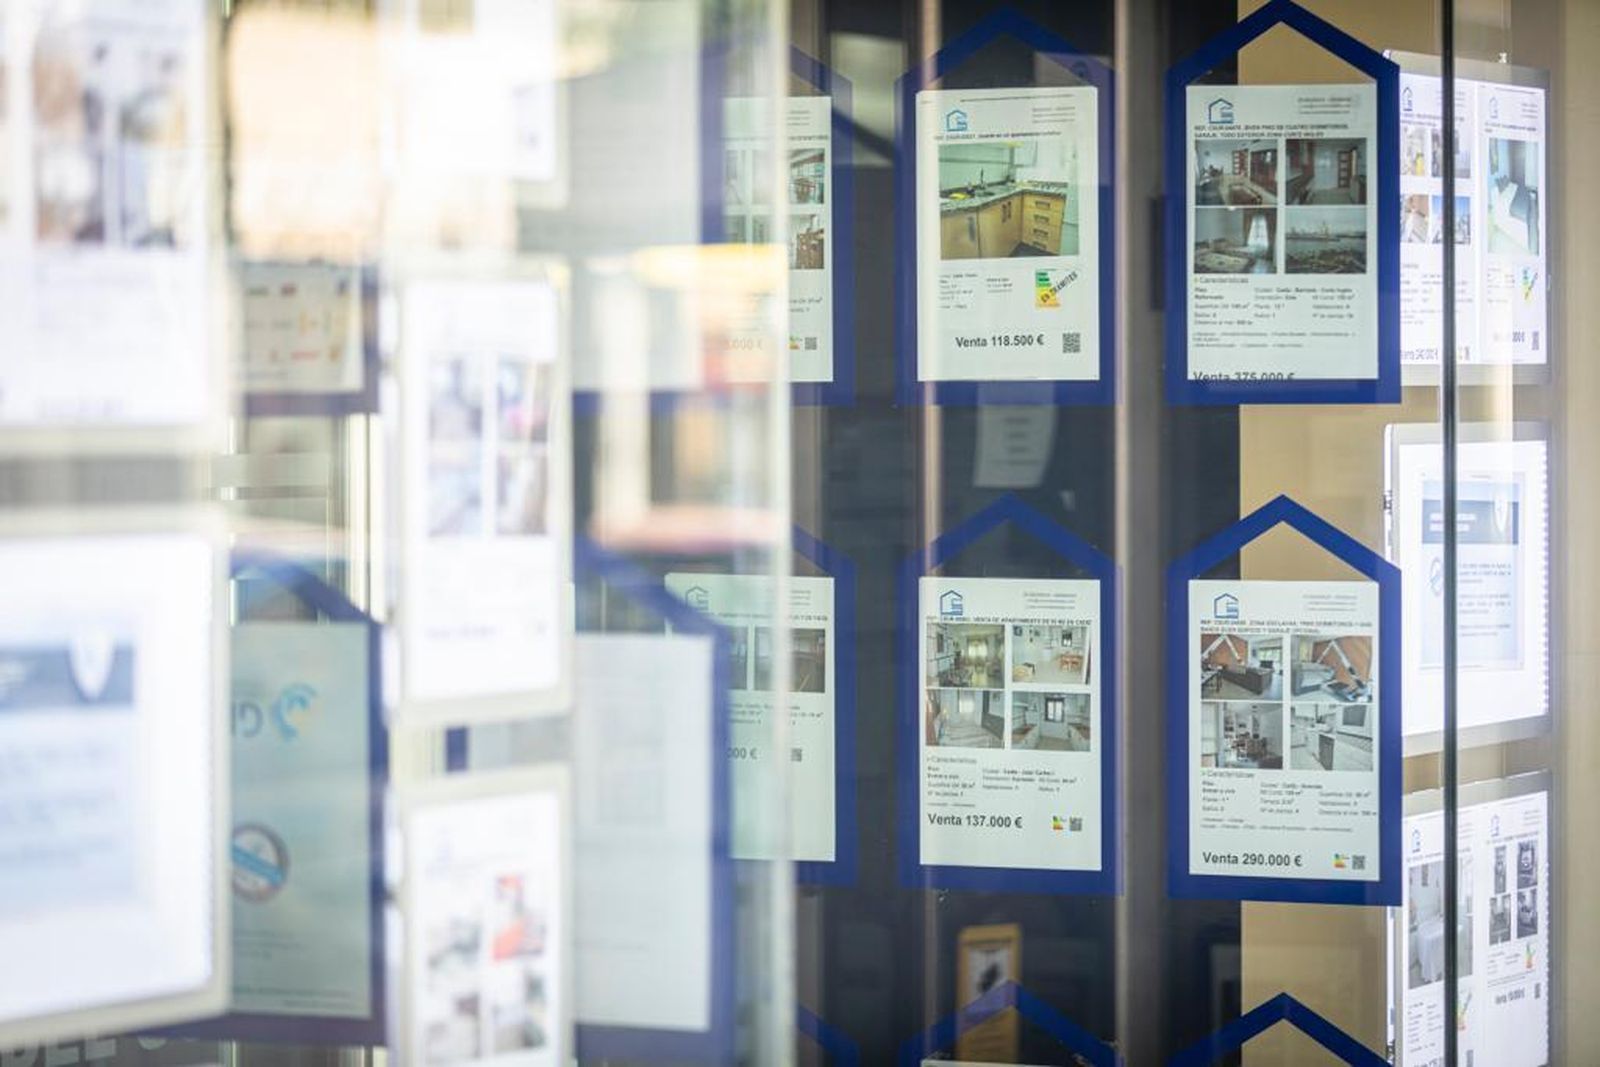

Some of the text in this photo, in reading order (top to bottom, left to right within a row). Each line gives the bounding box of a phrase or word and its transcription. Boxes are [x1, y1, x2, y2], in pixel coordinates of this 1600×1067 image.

[955, 334, 1045, 348] Venta 118.500 €
[928, 814, 1023, 829] Venta 137.000 €
[1202, 852, 1303, 867] Venta 290.000 €
